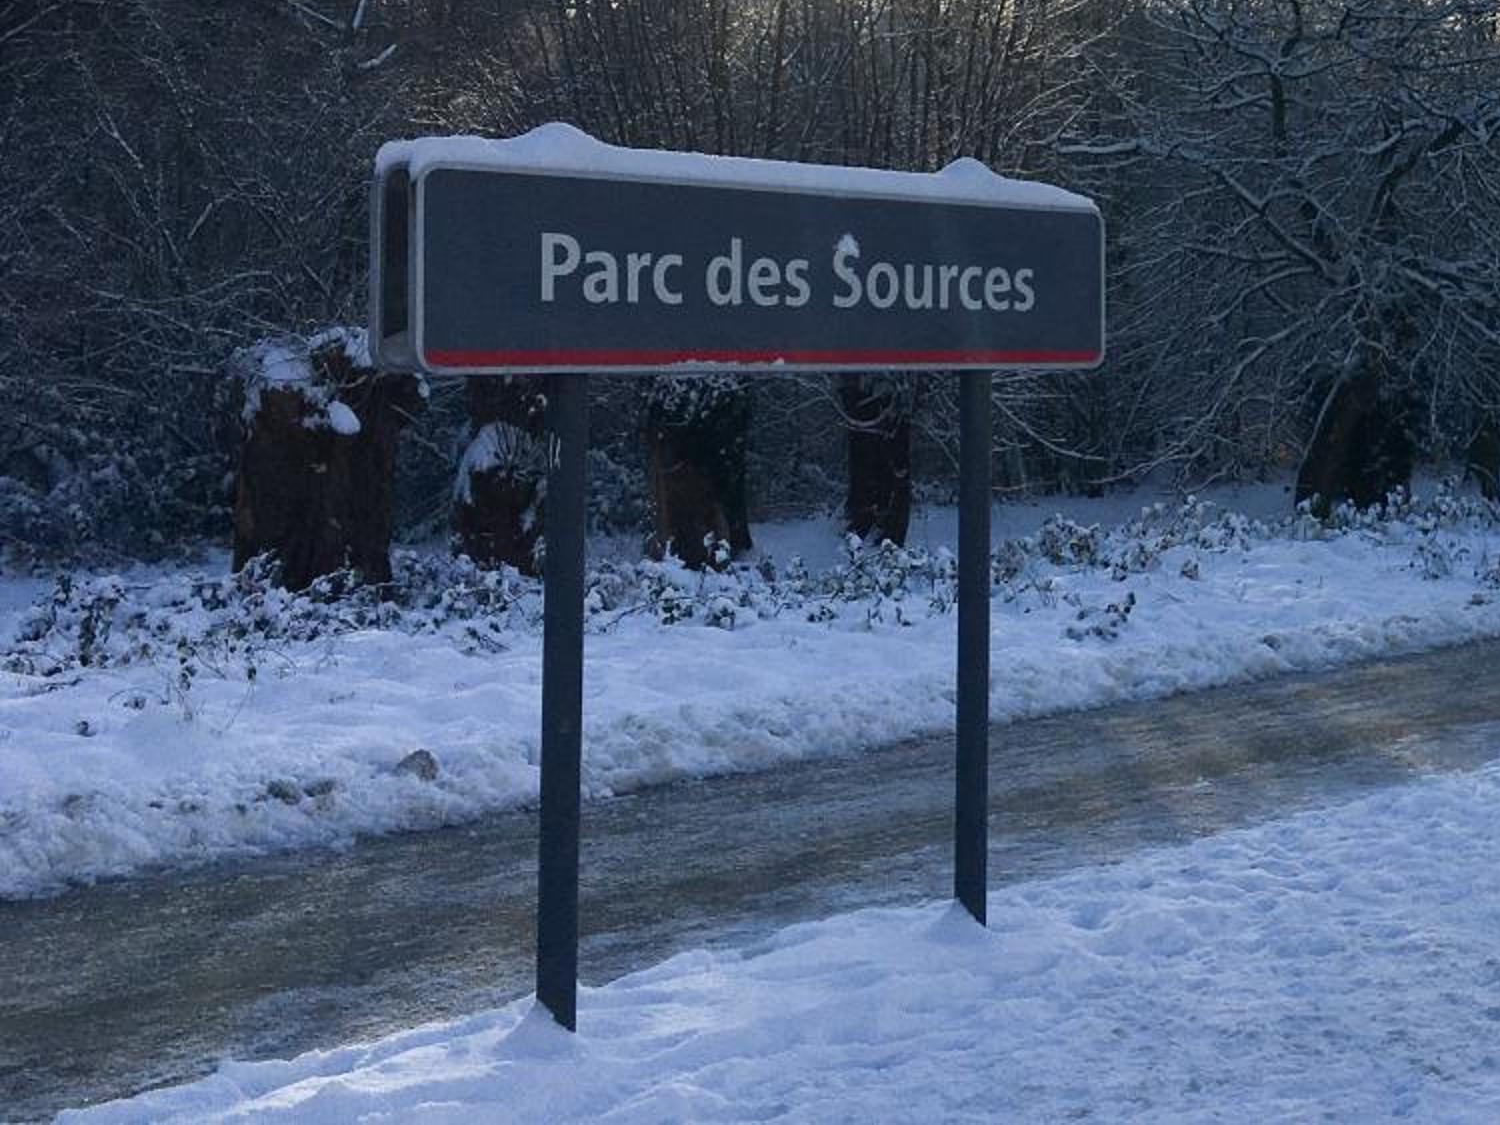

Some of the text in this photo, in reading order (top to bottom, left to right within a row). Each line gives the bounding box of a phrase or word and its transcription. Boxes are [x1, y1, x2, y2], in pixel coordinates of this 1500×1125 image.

[540, 232, 1036, 313] Parc des Sources
